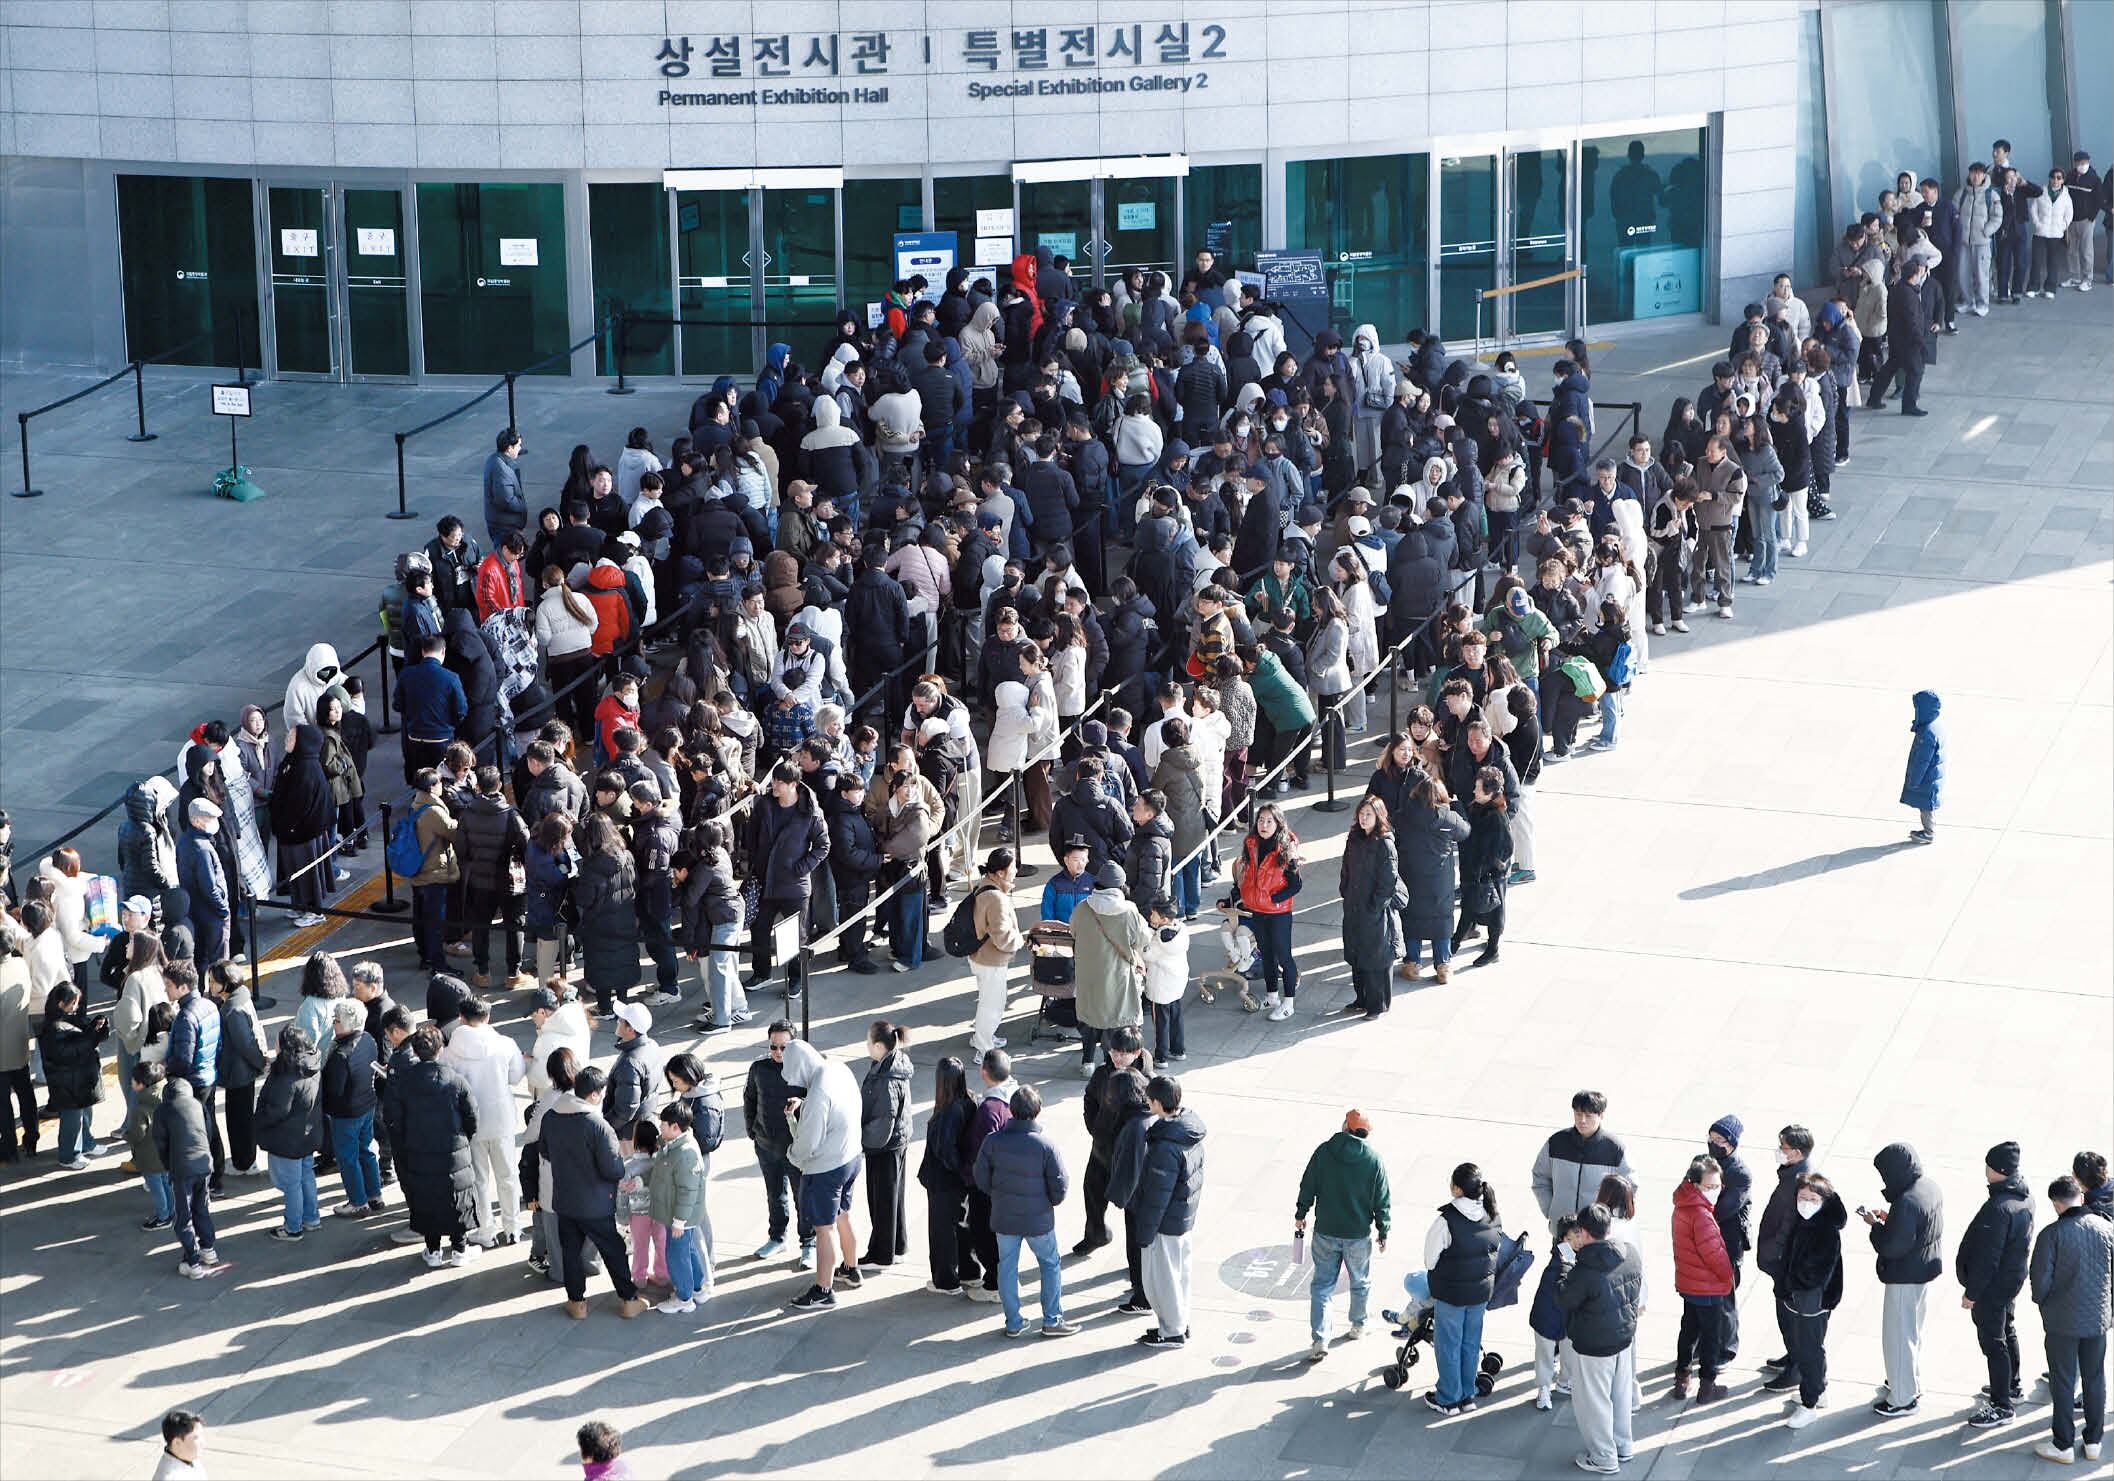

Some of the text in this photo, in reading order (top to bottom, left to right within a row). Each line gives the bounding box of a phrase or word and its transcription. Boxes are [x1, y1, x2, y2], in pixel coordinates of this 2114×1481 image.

[655, 32, 892, 78] 상설전시관
[658, 86, 889, 107] Permanent Exhibition Hall
[968, 72, 1209, 101] Special Exhibition Gallery 2
